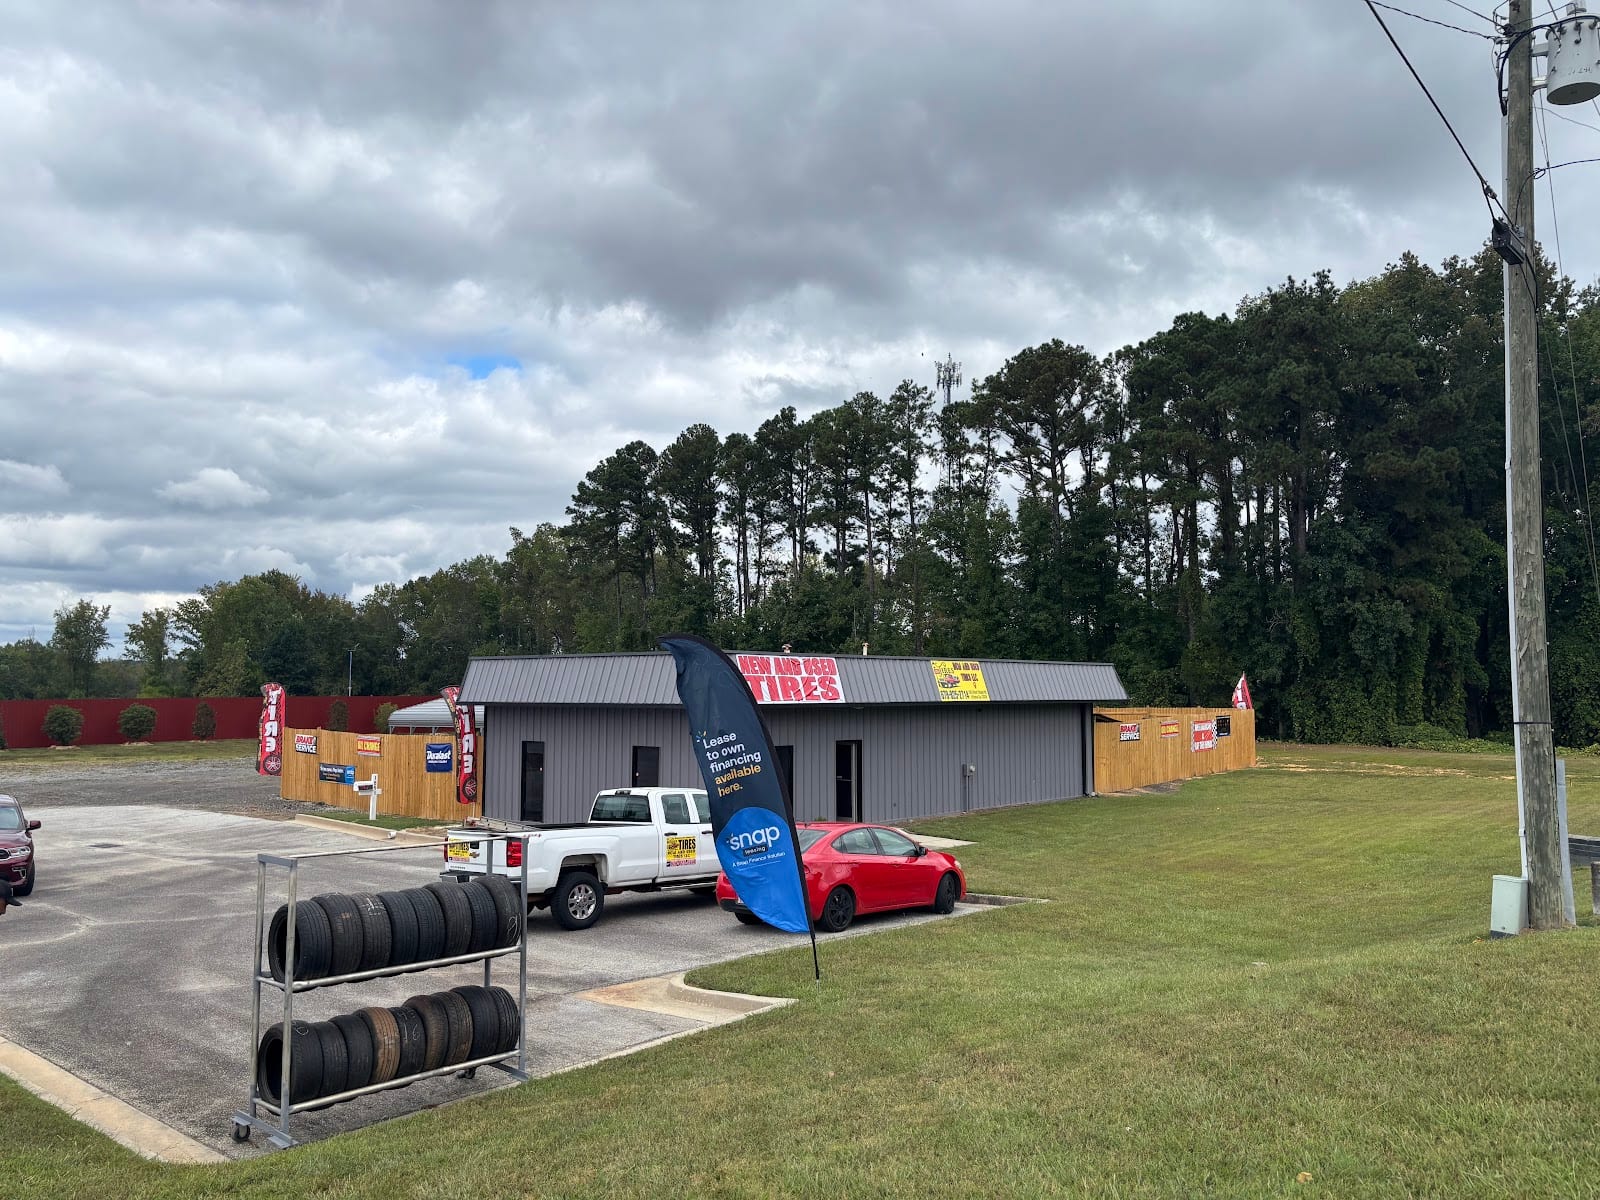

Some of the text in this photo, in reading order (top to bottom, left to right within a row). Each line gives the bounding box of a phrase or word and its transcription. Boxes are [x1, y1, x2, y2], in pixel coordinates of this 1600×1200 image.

[737, 655, 837, 676] NEW AND USED
[744, 675, 841, 701] TIRES
[296, 735, 314, 744] BRAKE
[703, 732, 737, 749] Lease
[1120, 732, 1140, 740] SERVICE
[296, 743, 317, 753] SERVICE
[426, 749, 451, 760] Duralast
[706, 743, 745, 761] to own
[709, 751, 762, 773] financing
[714, 764, 761, 785] available
[718, 782, 743, 797] here.
[679, 838, 697, 850] TIRES
[730, 826, 780, 850] snap
[744, 846, 766, 855] leasing
